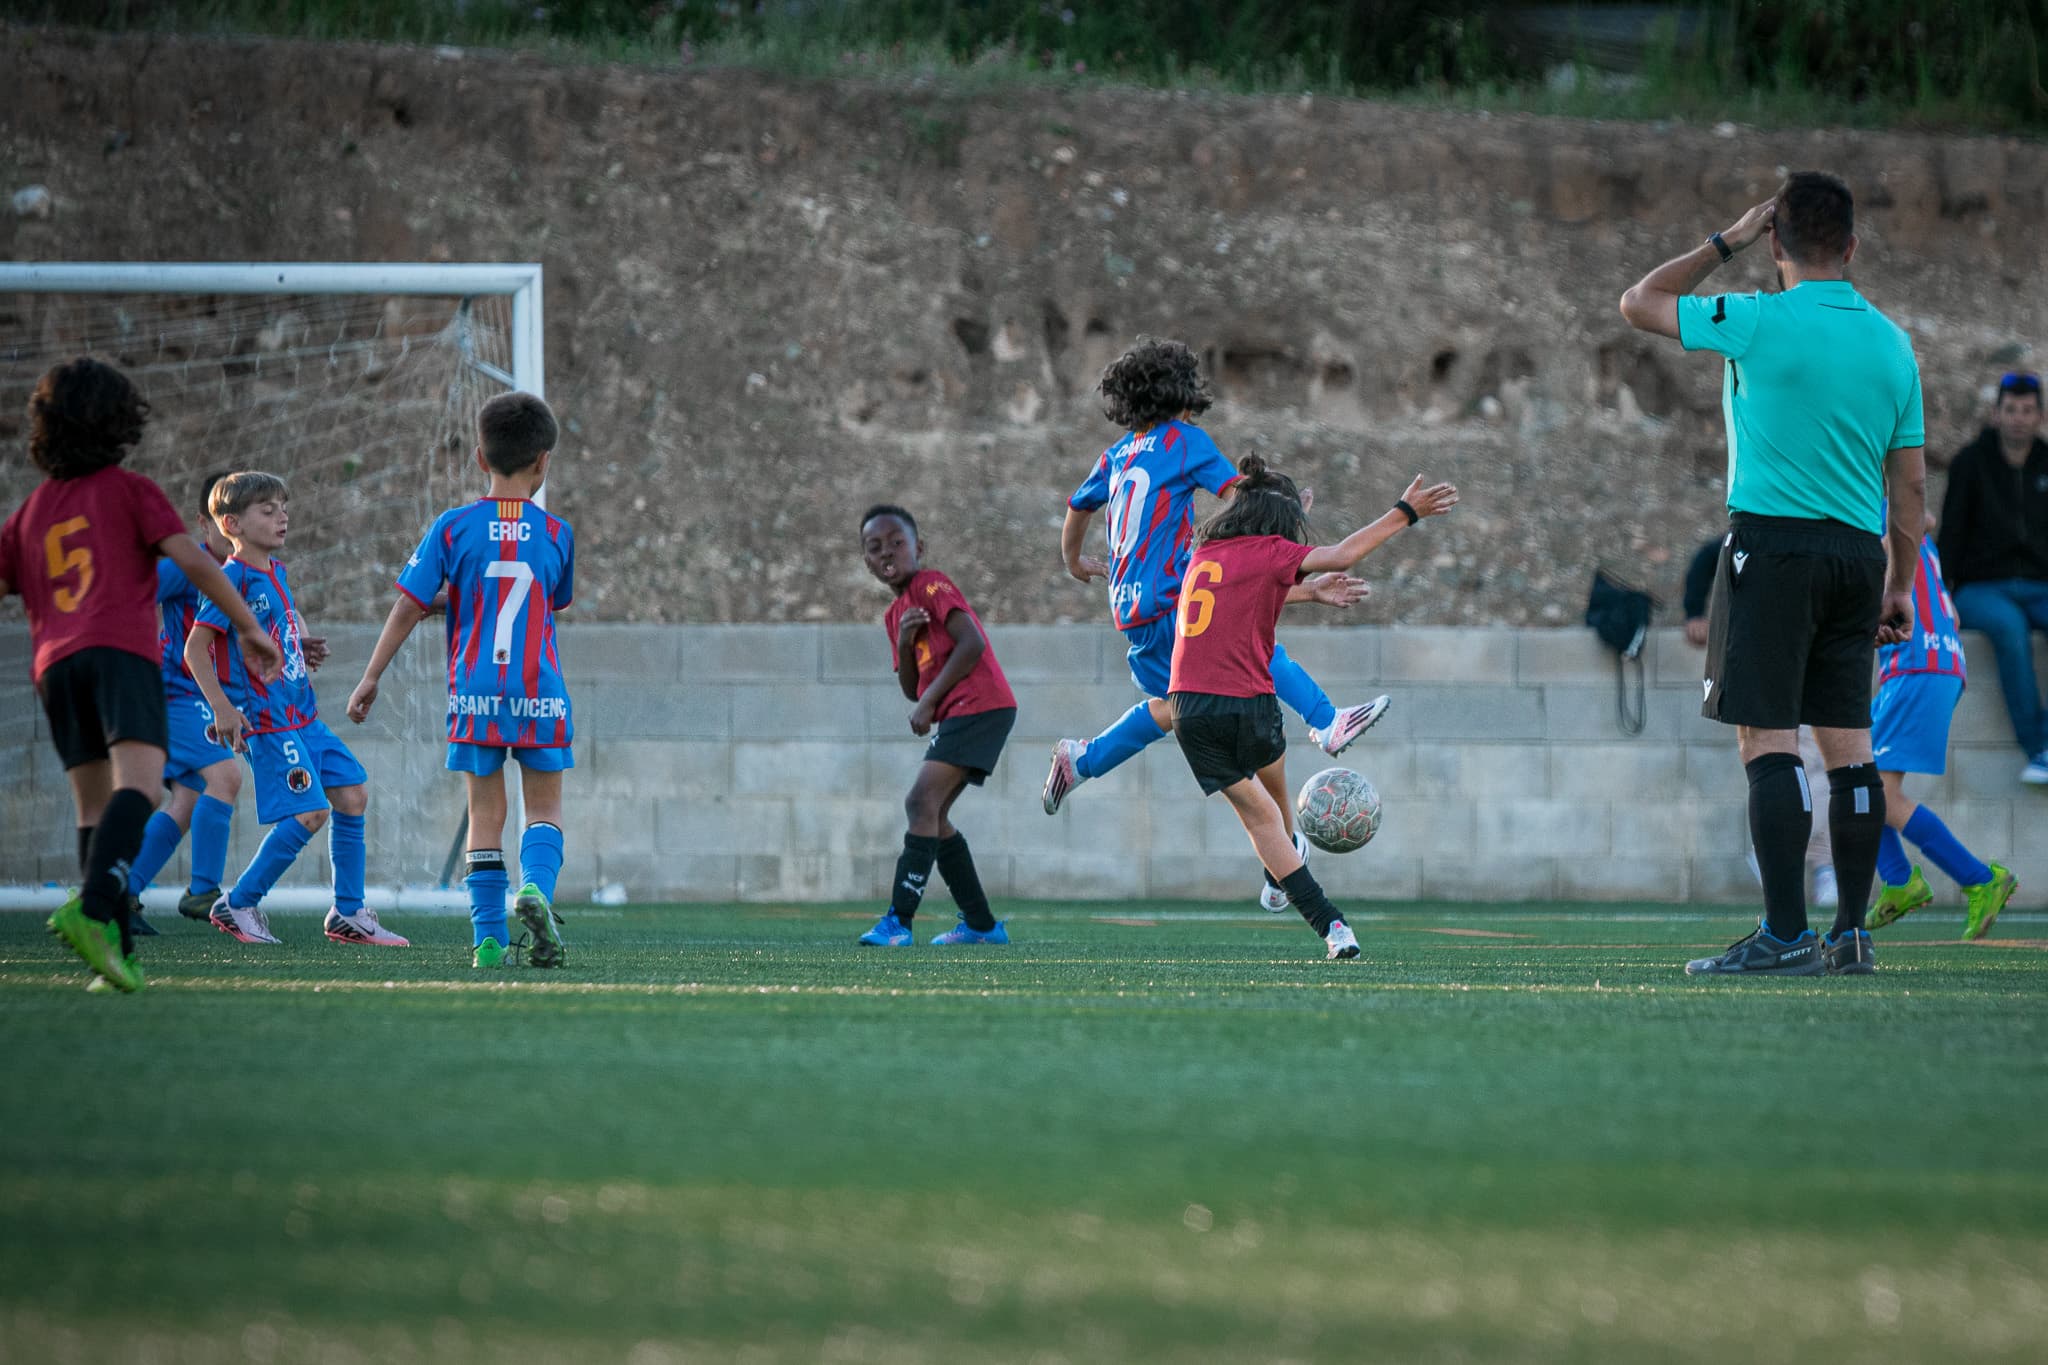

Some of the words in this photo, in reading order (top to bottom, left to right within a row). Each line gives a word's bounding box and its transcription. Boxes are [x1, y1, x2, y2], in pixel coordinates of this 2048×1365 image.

[488, 520, 532, 541] ERIC
[45, 515, 94, 612] 5
[1178, 560, 1223, 638] 6
[483, 560, 535, 665] 7
[194, 700, 212, 720] 3
[460, 694, 502, 717] SANT
[509, 697, 567, 720] VICENÇ
[283, 740, 300, 765] 5
[1781, 947, 1812, 960] SCOTT
